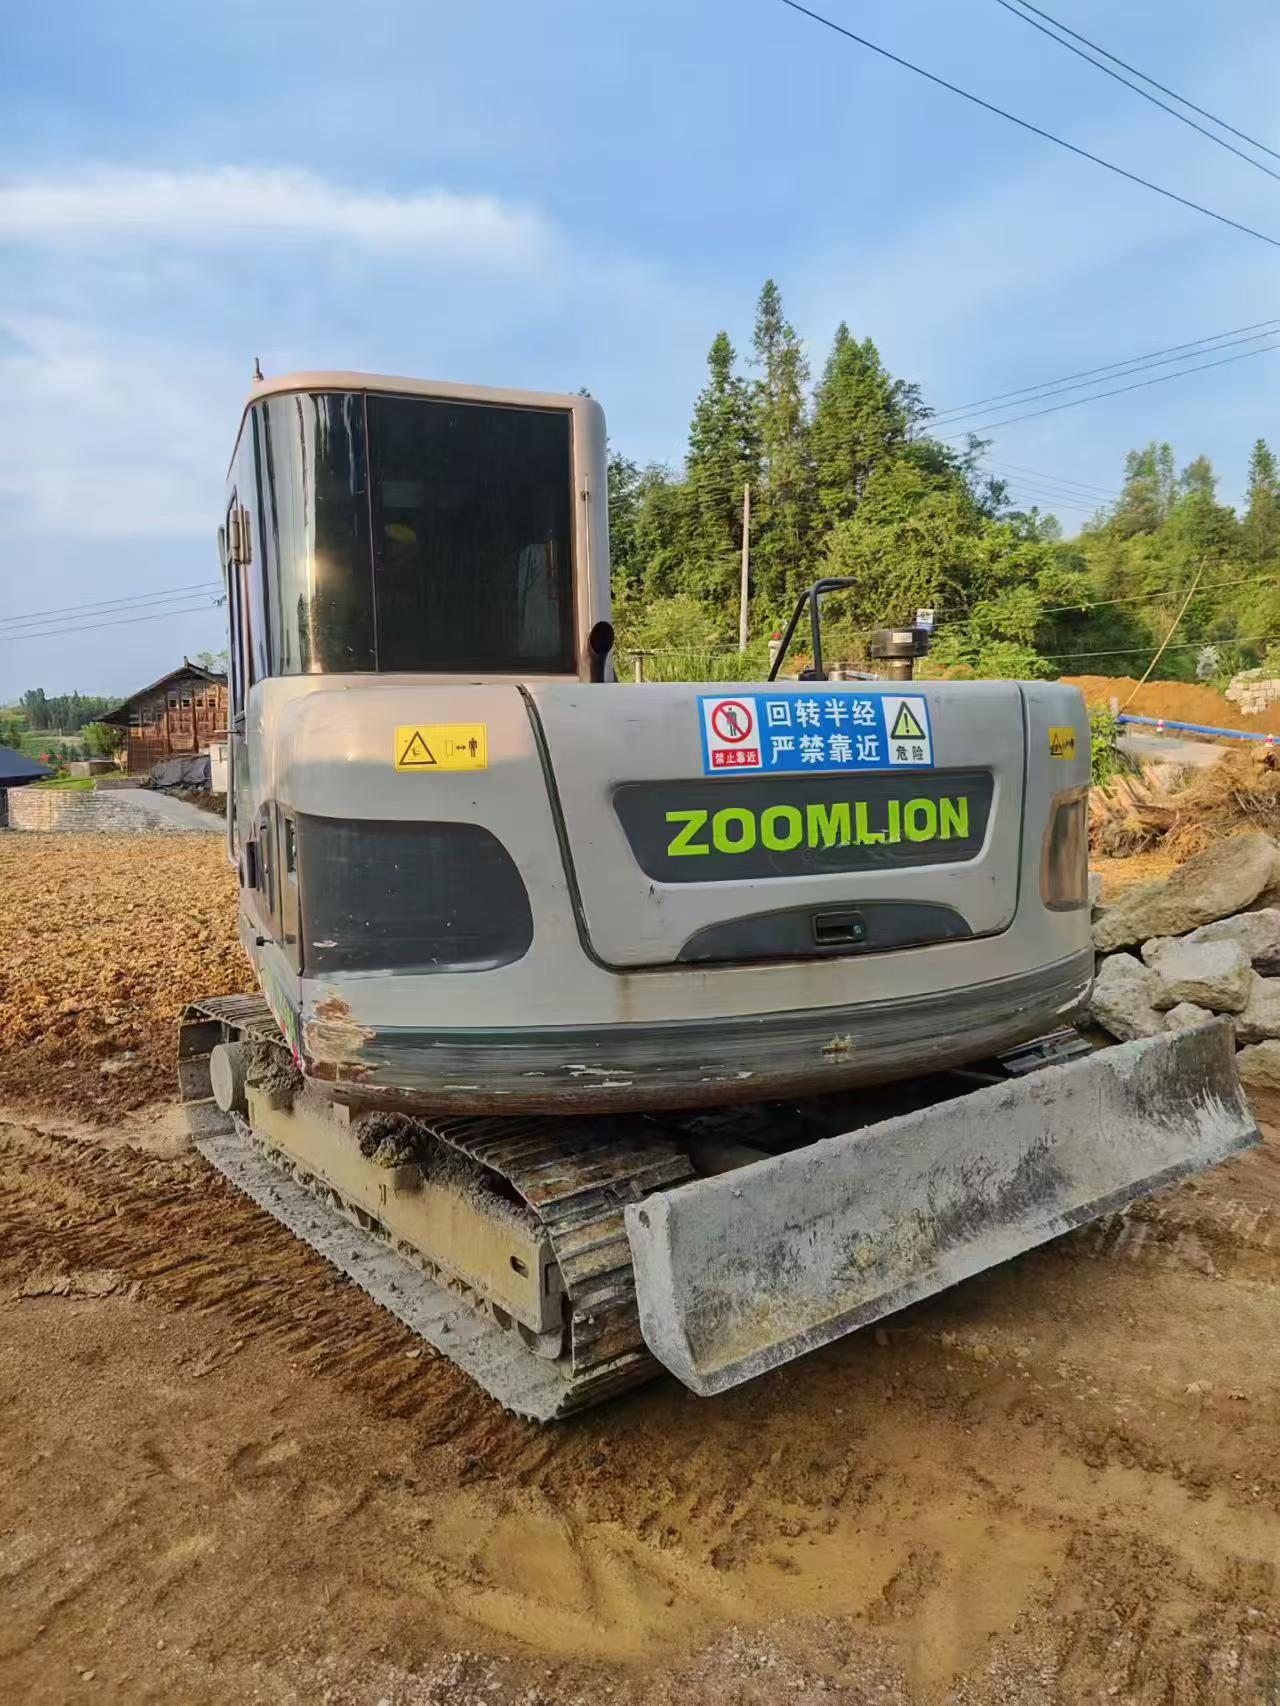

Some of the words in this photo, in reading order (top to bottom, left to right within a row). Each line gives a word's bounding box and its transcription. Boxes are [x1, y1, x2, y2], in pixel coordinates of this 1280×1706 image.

[766, 698, 877, 728] 回转半经
[714, 751, 757, 764] 禁止靠近
[770, 734, 881, 764] 严禁靠近
[896, 745, 924, 761] 危险
[665, 797, 969, 857] ZOOMLION
